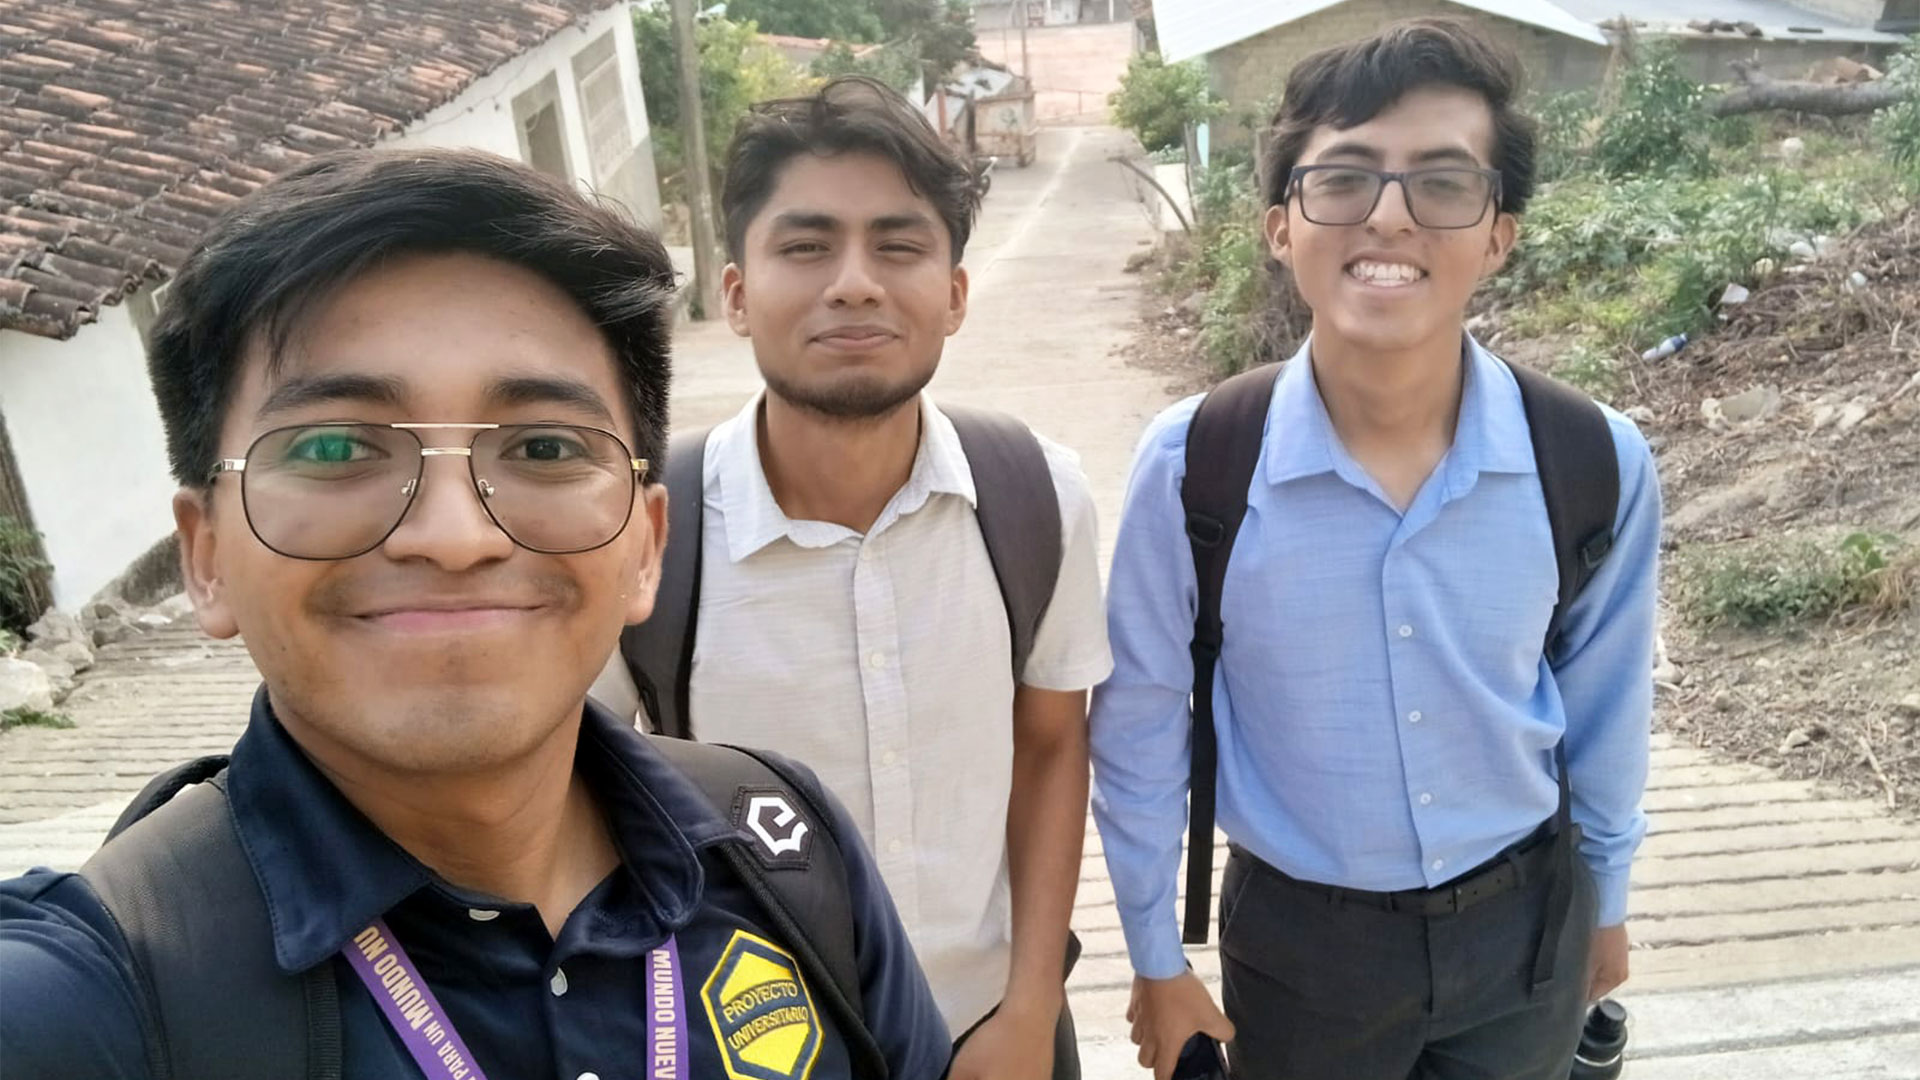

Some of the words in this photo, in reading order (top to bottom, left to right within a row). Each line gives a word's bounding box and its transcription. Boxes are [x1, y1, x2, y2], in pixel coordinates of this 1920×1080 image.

[353, 926, 389, 962] NU
[374, 953, 434, 1031] MUNDO
[652, 949, 676, 1022] MUNDO
[722, 981, 798, 1024] PROYECTO
[423, 1020, 446, 1046] UN
[727, 1006, 809, 1050] UNIVERSITARIO
[437, 1040, 470, 1080] PARA
[655, 1026, 677, 1080] NUEV
